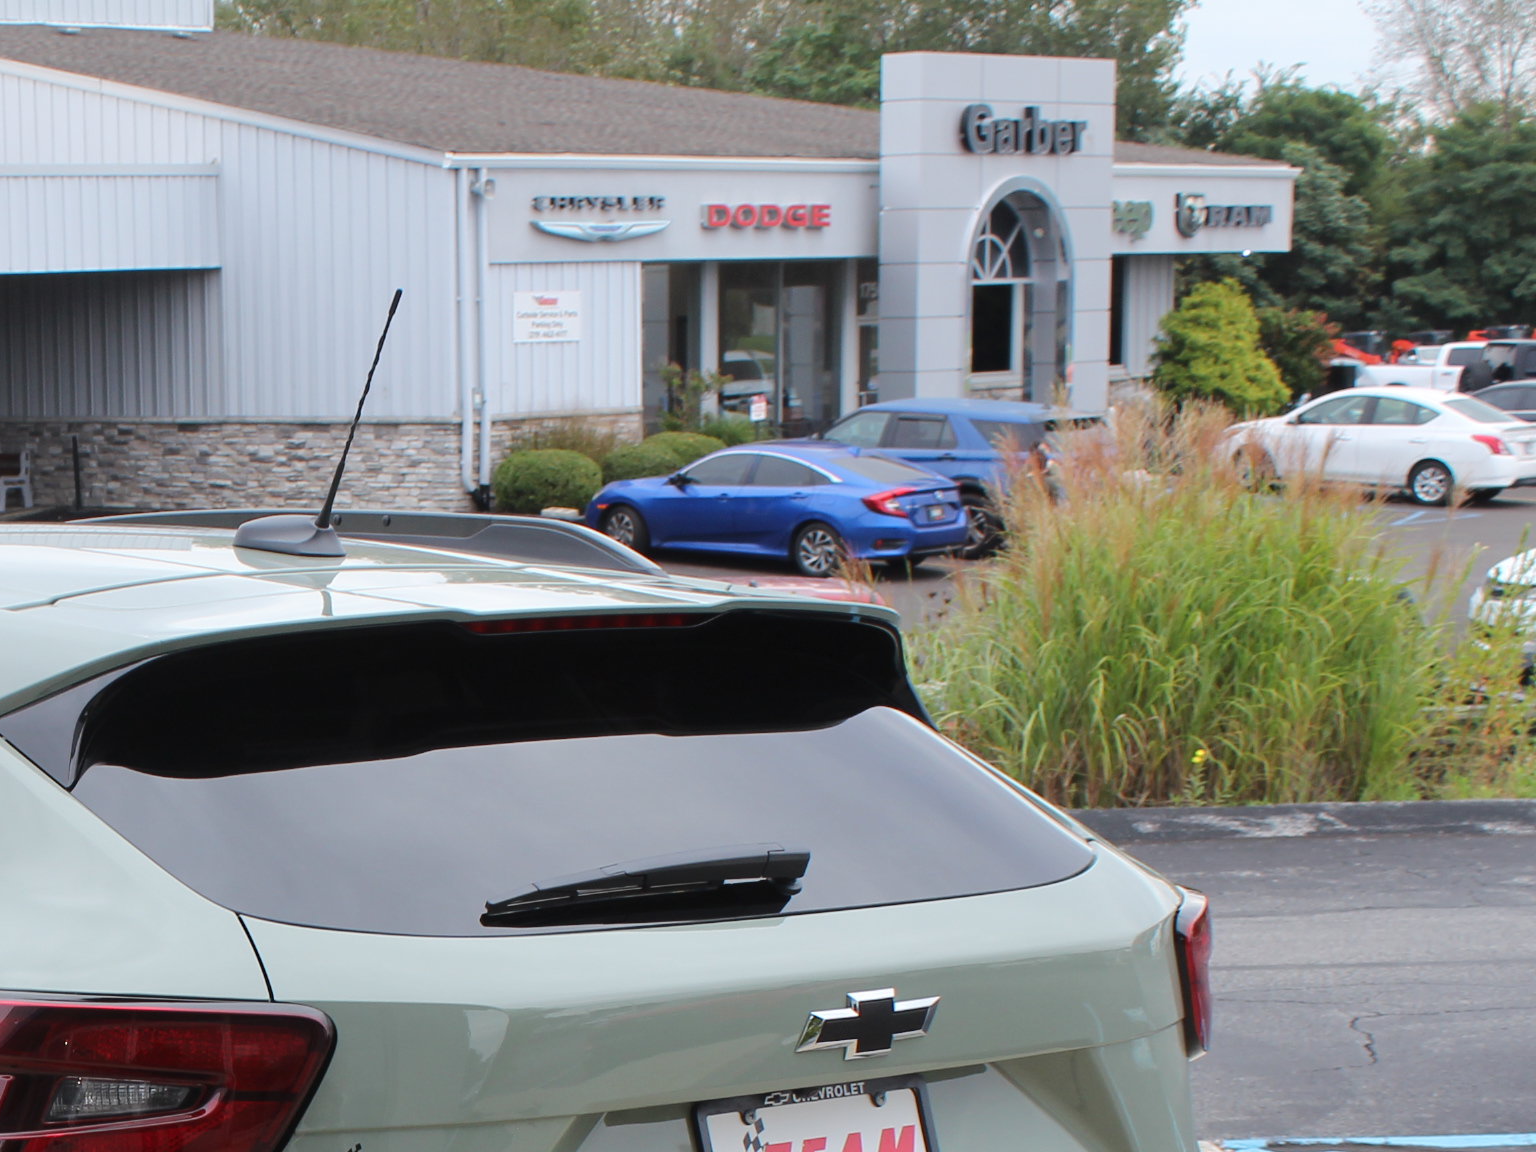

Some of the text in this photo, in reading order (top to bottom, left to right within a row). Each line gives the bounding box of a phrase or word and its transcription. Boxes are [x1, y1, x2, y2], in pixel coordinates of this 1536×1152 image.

[961, 104, 1087, 155] Garber
[531, 196, 666, 211] CHRYSLER
[704, 203, 832, 228] DODGE
[1208, 204, 1272, 228] RAM
[792, 1081, 866, 1104] CVROLET
